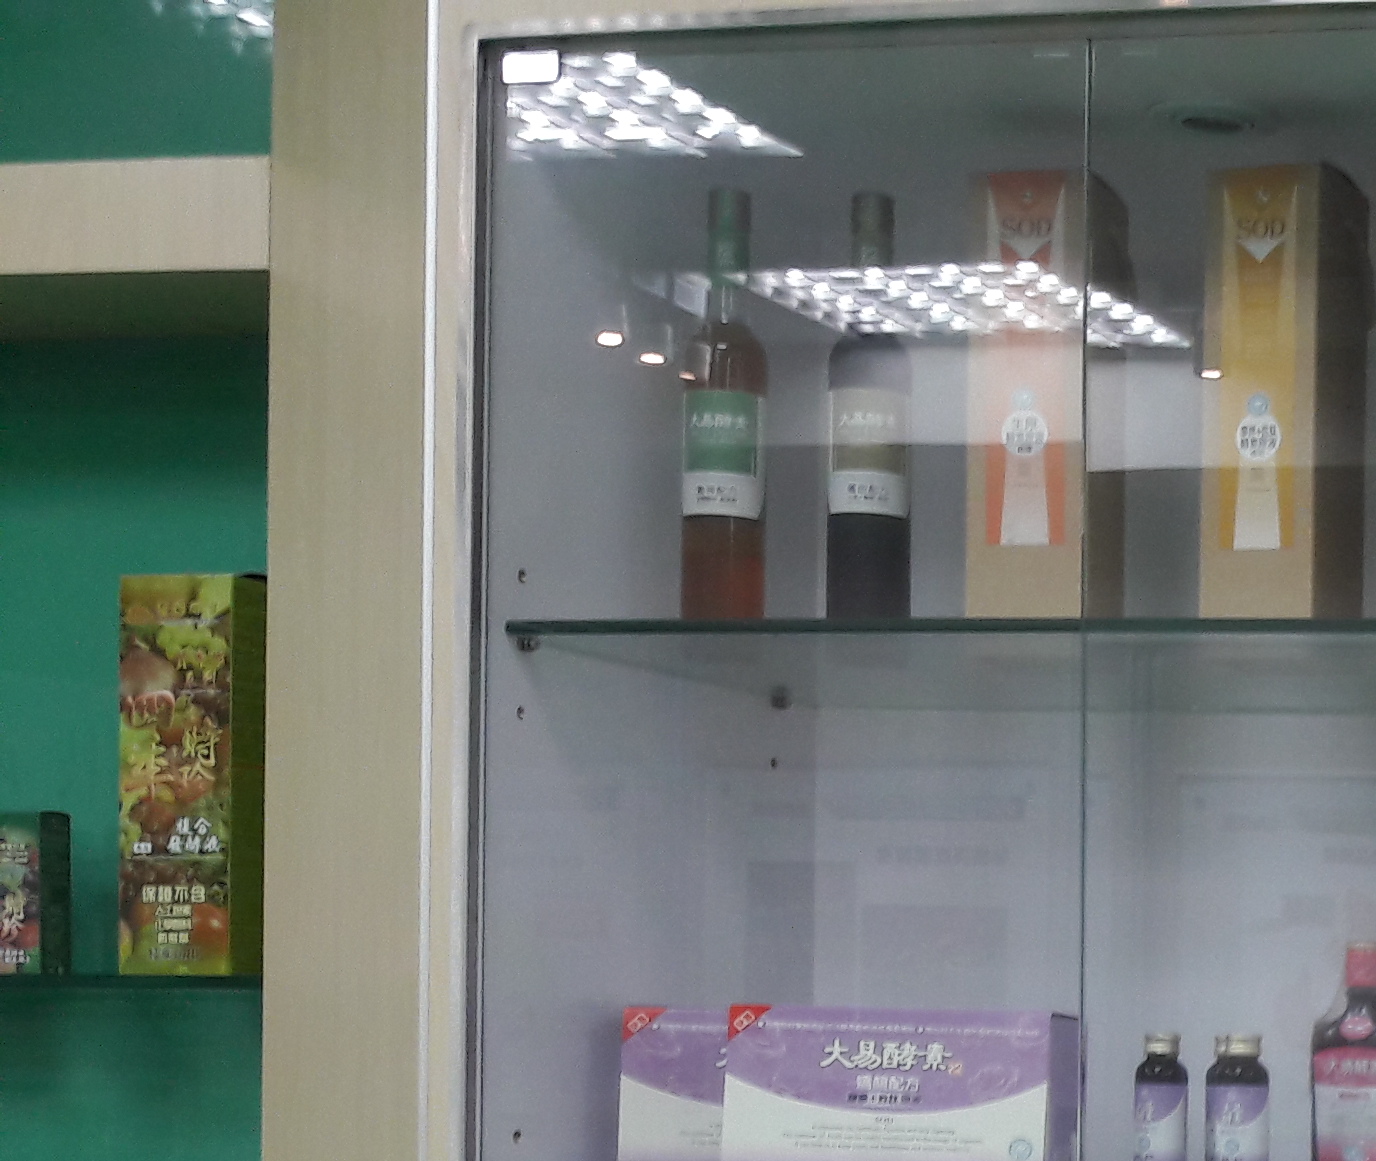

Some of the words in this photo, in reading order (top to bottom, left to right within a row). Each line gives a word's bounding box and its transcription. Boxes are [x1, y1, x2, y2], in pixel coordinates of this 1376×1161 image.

[1235, 217, 1286, 238] SOD
[819, 1036, 953, 1072] 大易酵素
